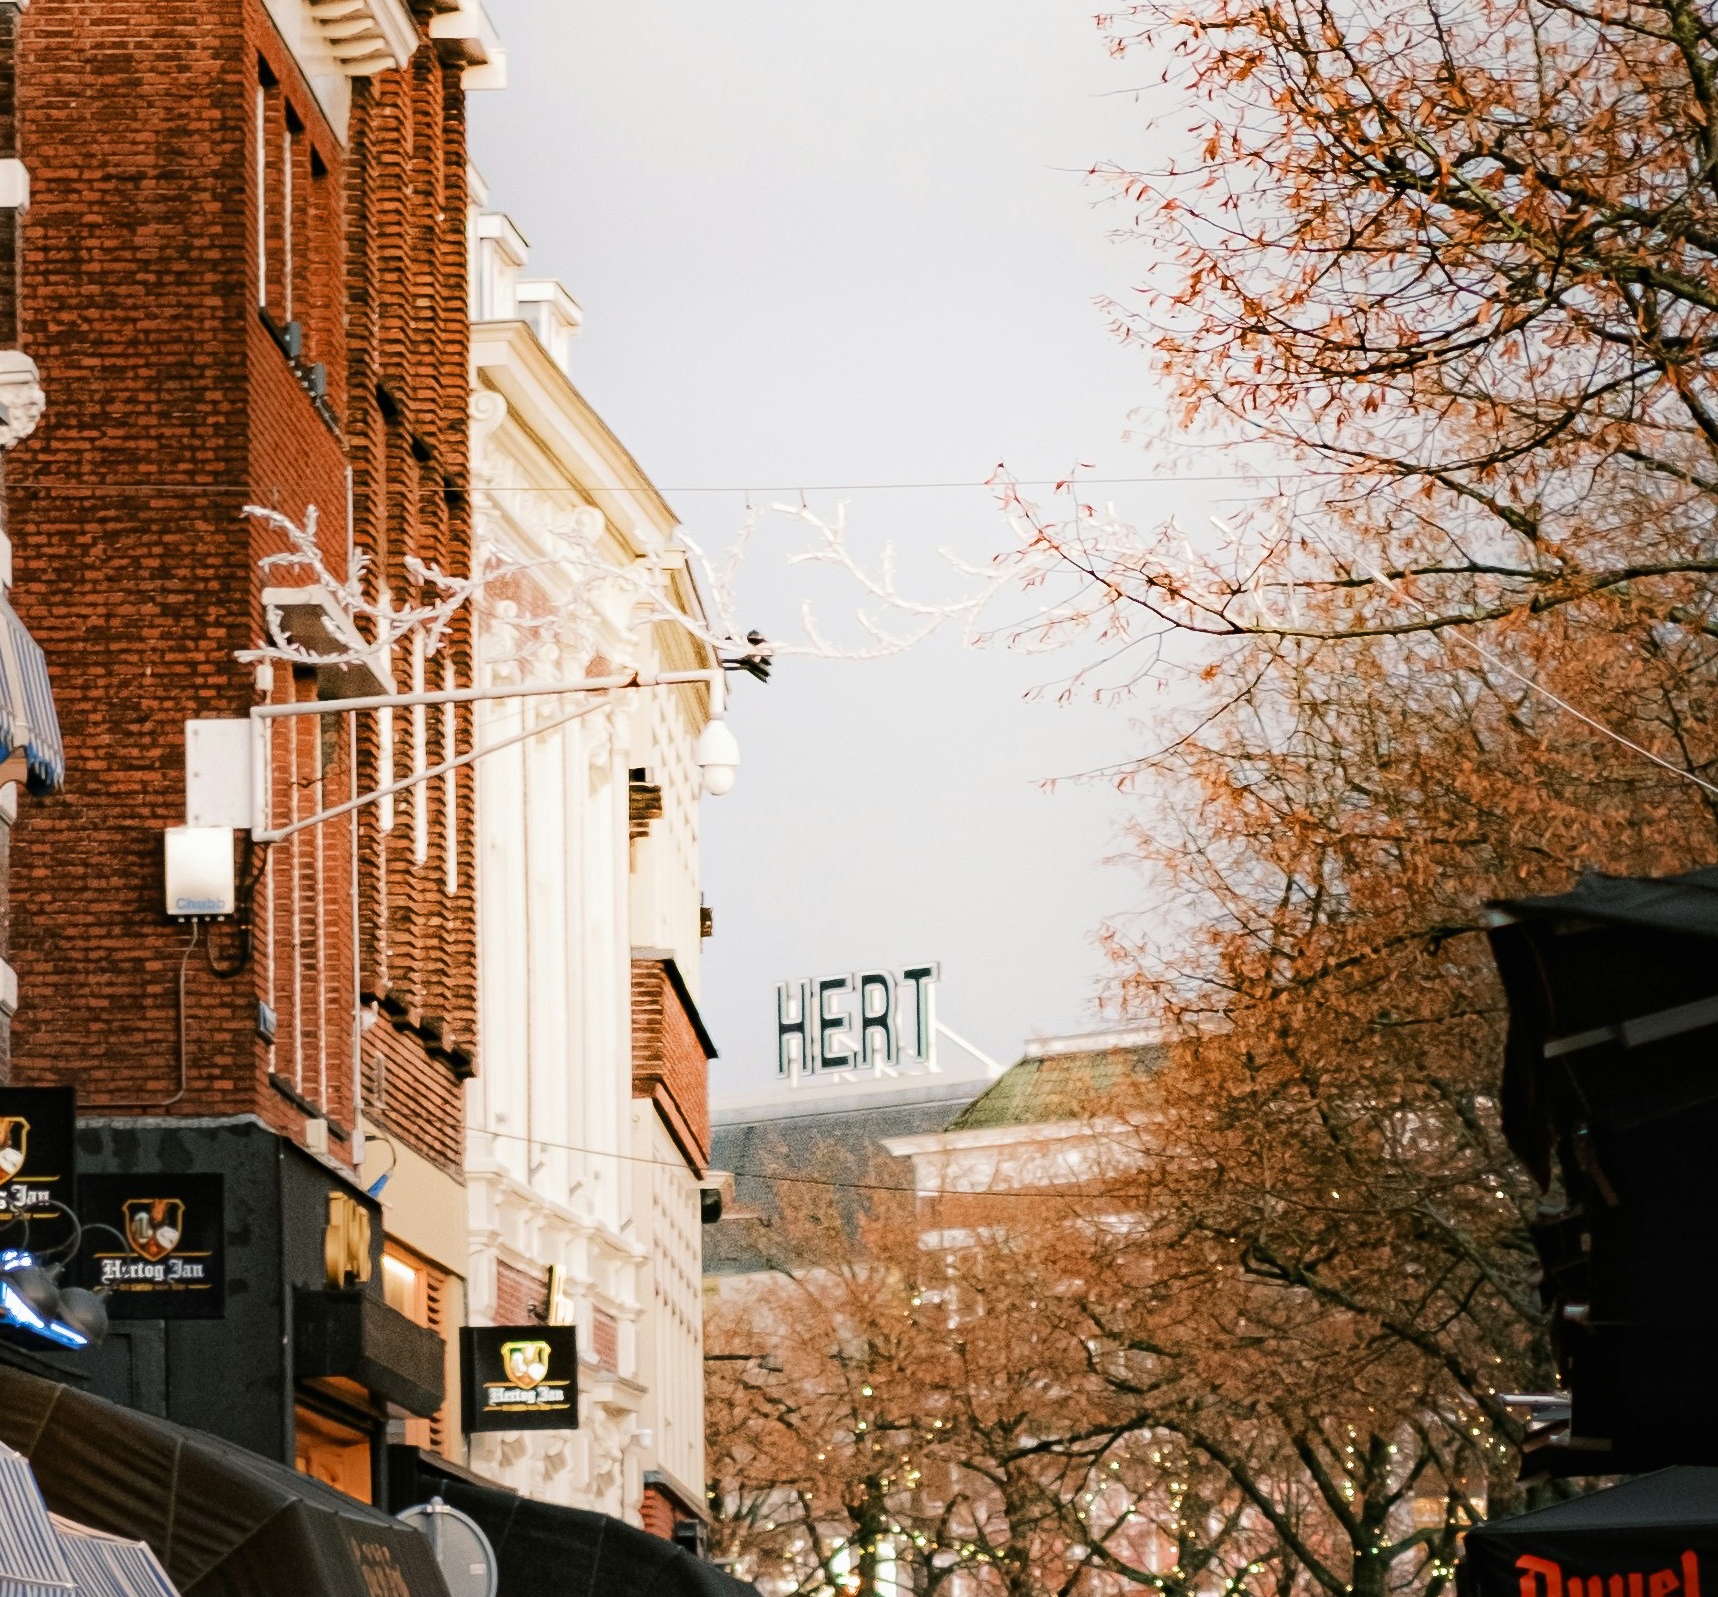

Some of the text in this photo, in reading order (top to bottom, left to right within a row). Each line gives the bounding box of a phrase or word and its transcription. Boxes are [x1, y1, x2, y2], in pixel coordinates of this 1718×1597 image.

[774, 961, 940, 1079] HERT
[10, 1184, 51, 1215] Jan
[100, 1257, 205, 1284] Hertog Jan
